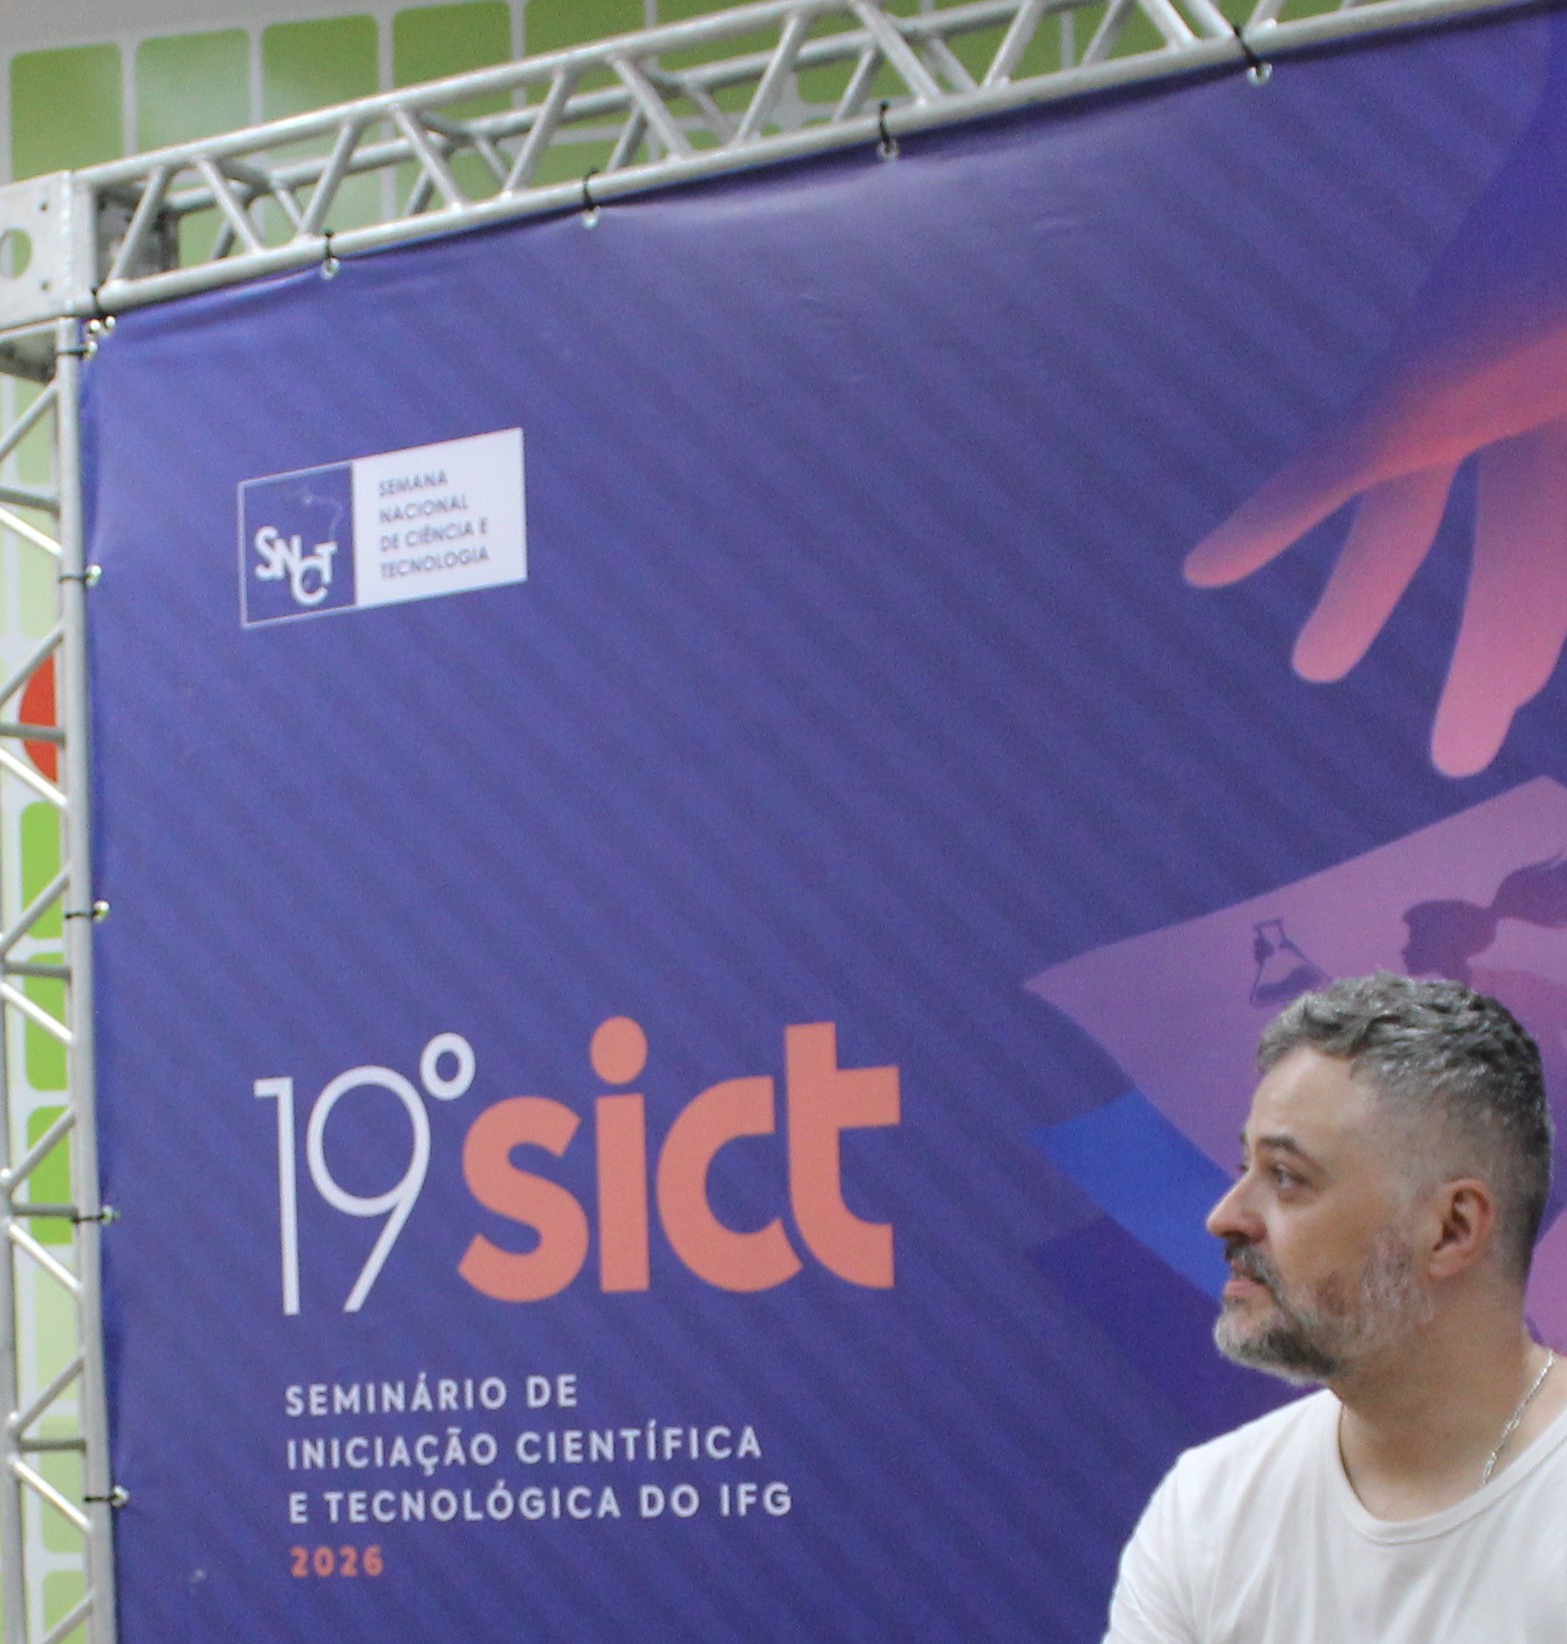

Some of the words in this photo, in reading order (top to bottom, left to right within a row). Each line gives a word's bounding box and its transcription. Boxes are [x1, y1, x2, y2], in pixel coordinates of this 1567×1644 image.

[378, 470, 448, 497] SEMANA
[379, 494, 468, 524] NACIONAL
[380, 533, 399, 552] DE
[405, 519, 472, 548] CIÊNCIA
[479, 517, 488, 535] E
[254, 525, 337, 606] SNCT
[380, 546, 489, 579] TECNOLOGIA
[457, 1016, 900, 1302] sict
[285, 1373, 508, 1417] SEMINÁRIO
[526, 1374, 578, 1408] DE
[287, 1427, 498, 1476] INICIAÇÃO
[516, 1420, 762, 1464] CIENTÍFICA
[289, 1492, 308, 1524] E
[327, 1480, 621, 1523] TECNOLÓGICA
[641, 1483, 699, 1518] DO
[720, 1482, 792, 1516] IFG
[290, 1545, 384, 1577] 2026
